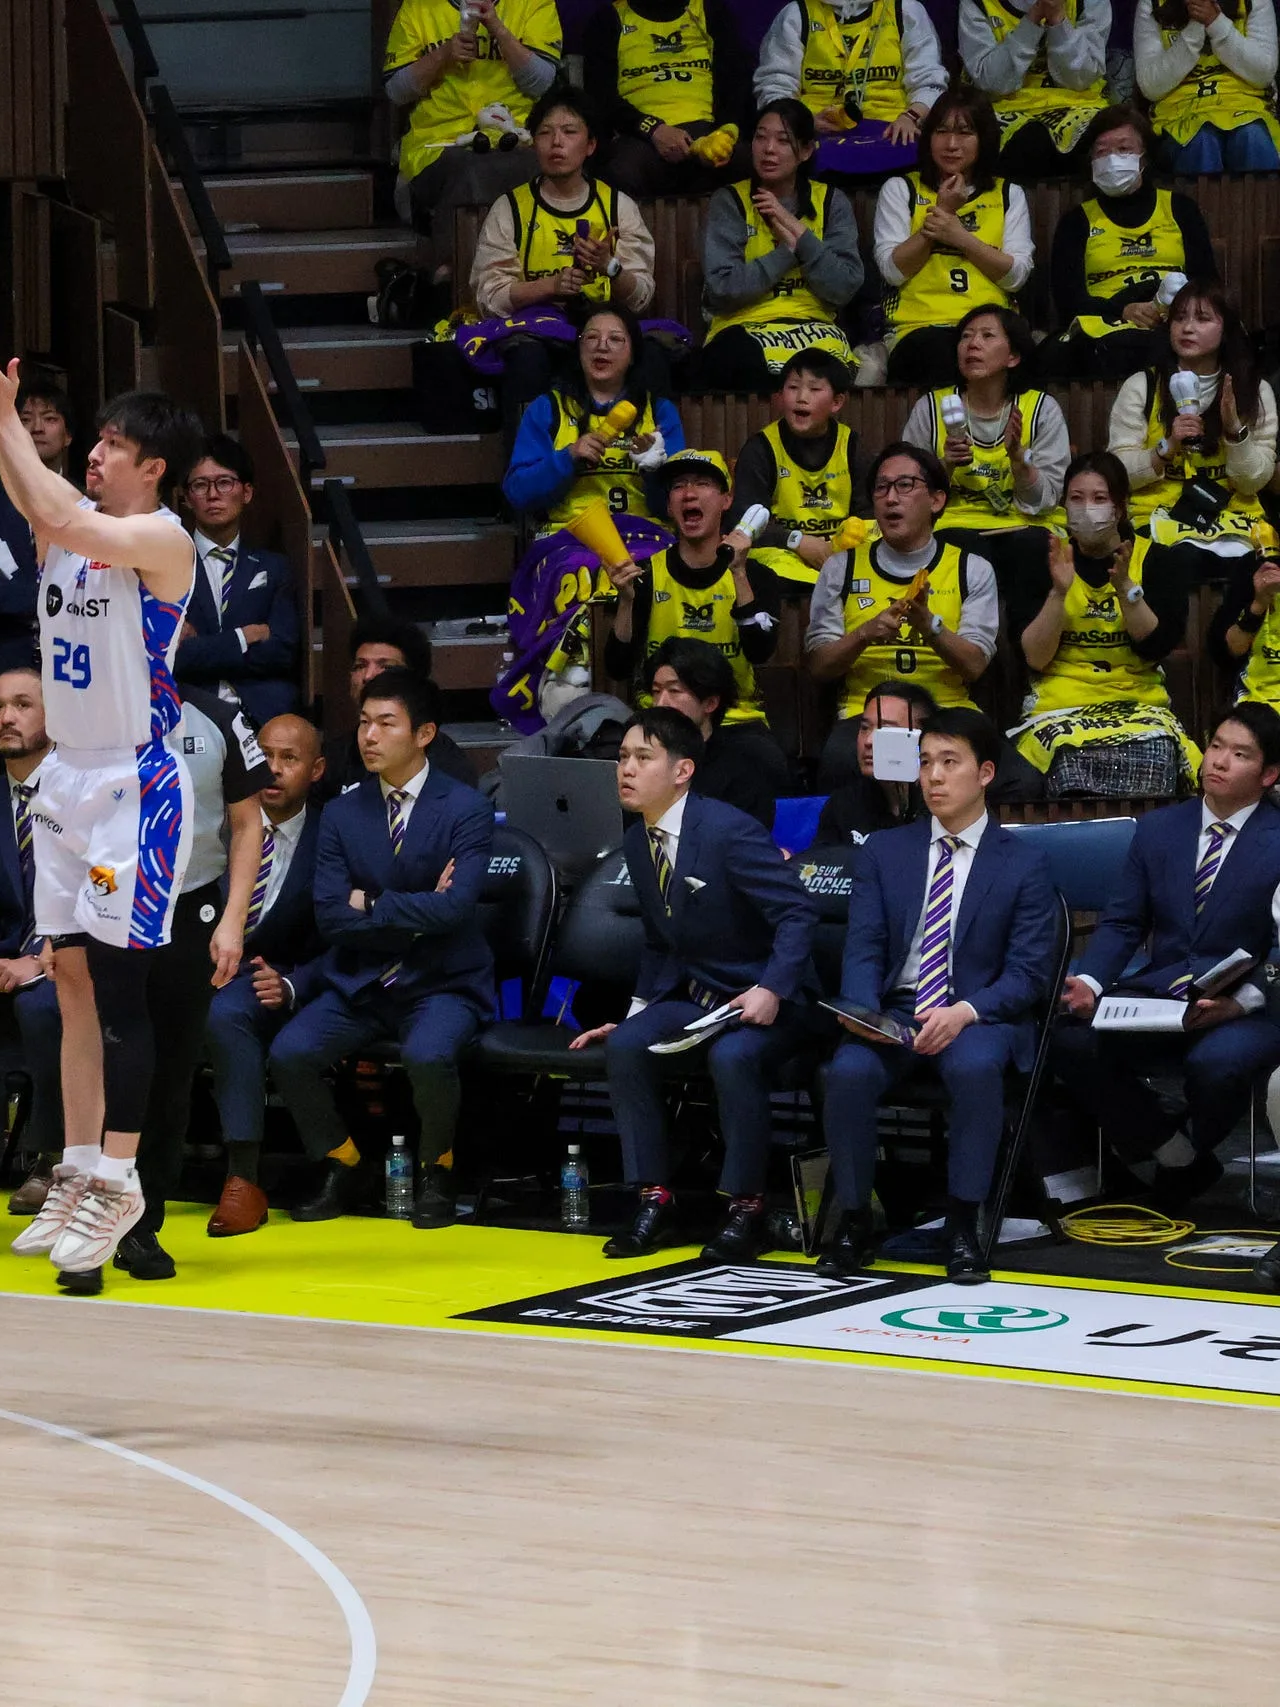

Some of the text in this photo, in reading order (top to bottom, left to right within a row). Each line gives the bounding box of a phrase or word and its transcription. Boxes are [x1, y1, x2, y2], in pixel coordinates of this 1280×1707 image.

[949, 267, 969, 293] 9
[608, 487, 629, 514] 9
[53, 636, 92, 689] 29
[895, 648, 918, 674] 0
[519, 1308, 711, 1329] B.LEAGUE
[834, 1326, 971, 1344] RESONA
